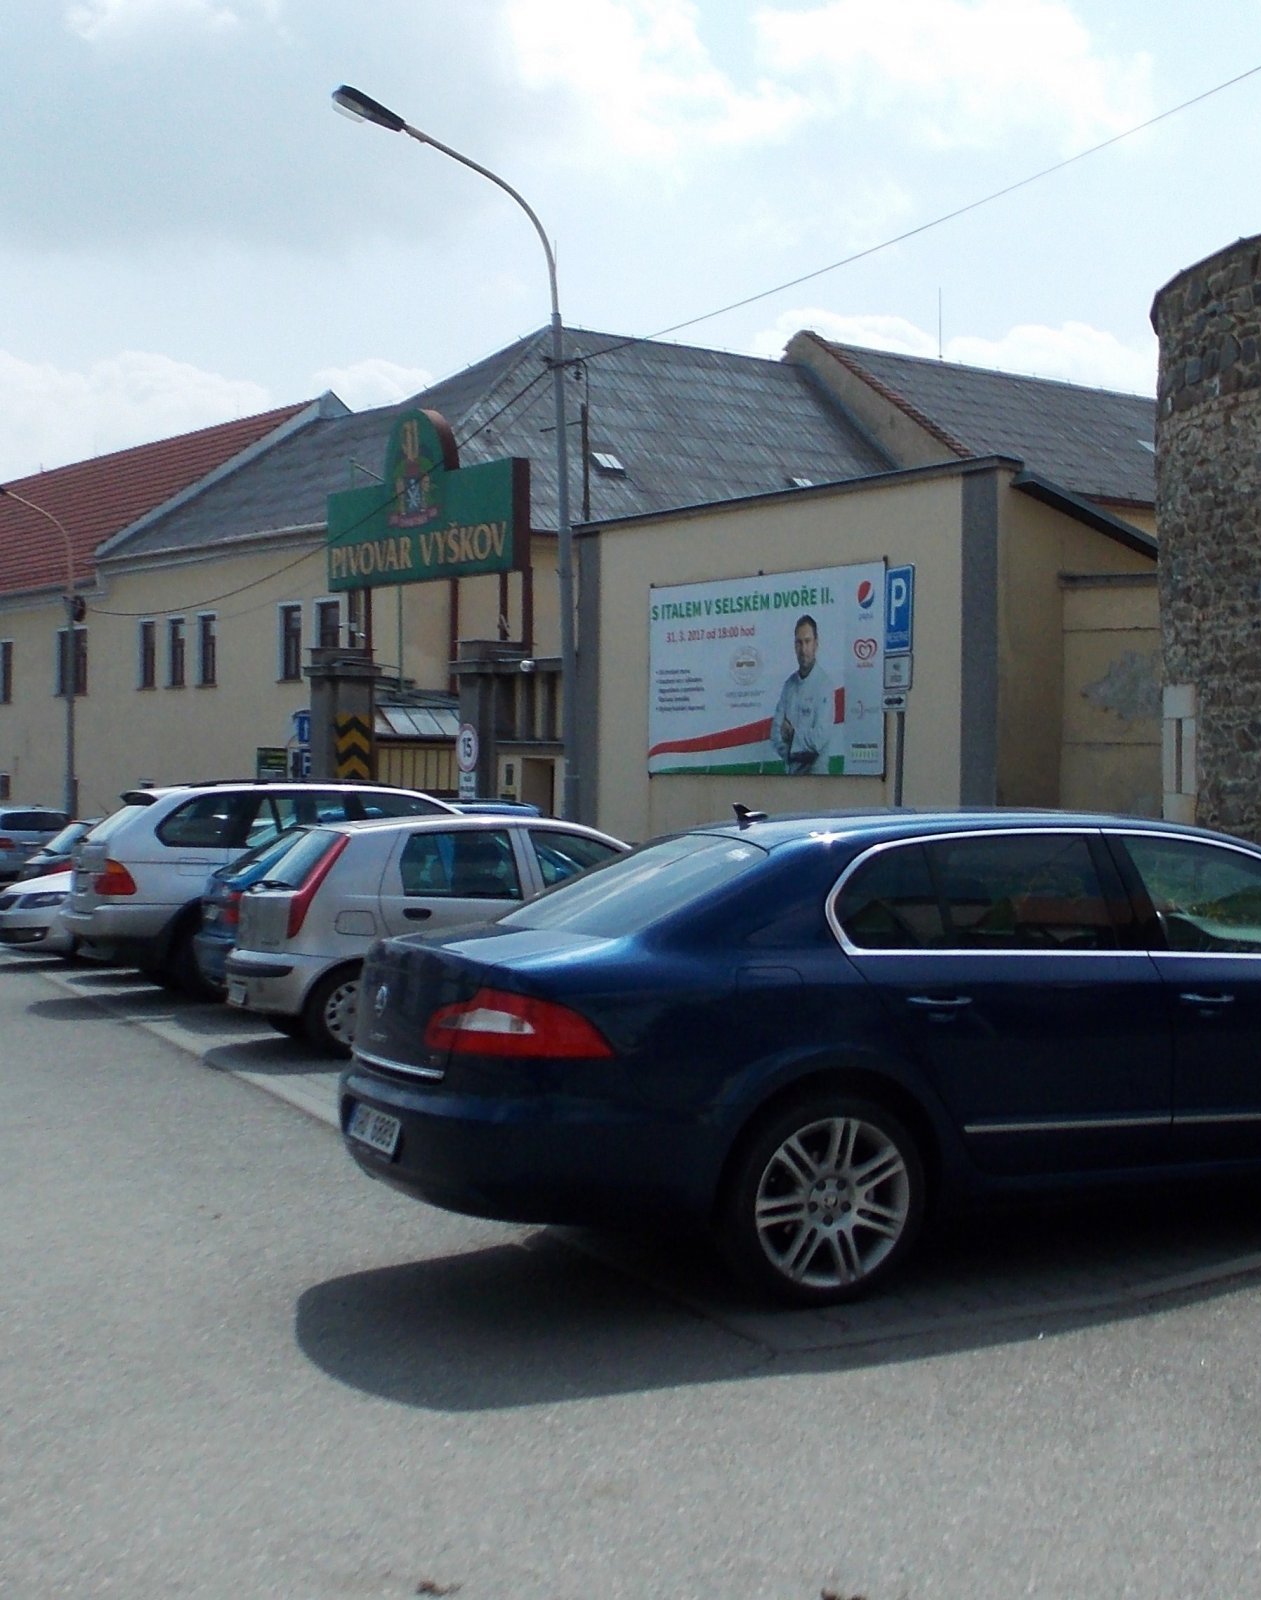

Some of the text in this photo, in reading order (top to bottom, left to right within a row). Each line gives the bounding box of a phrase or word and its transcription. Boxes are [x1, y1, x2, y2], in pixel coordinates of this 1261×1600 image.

[331, 522, 507, 579] PIVOVAR VYŠKOV
[652, 605, 660, 621] S
[661, 602, 701, 620] ITALEM
[704, 600, 713, 617] V
[715, 591, 770, 615] SELSKÉM
[773, 585, 817, 609] DVOŘE
[890, 577, 906, 626] P
[462, 737, 473, 758] 15
